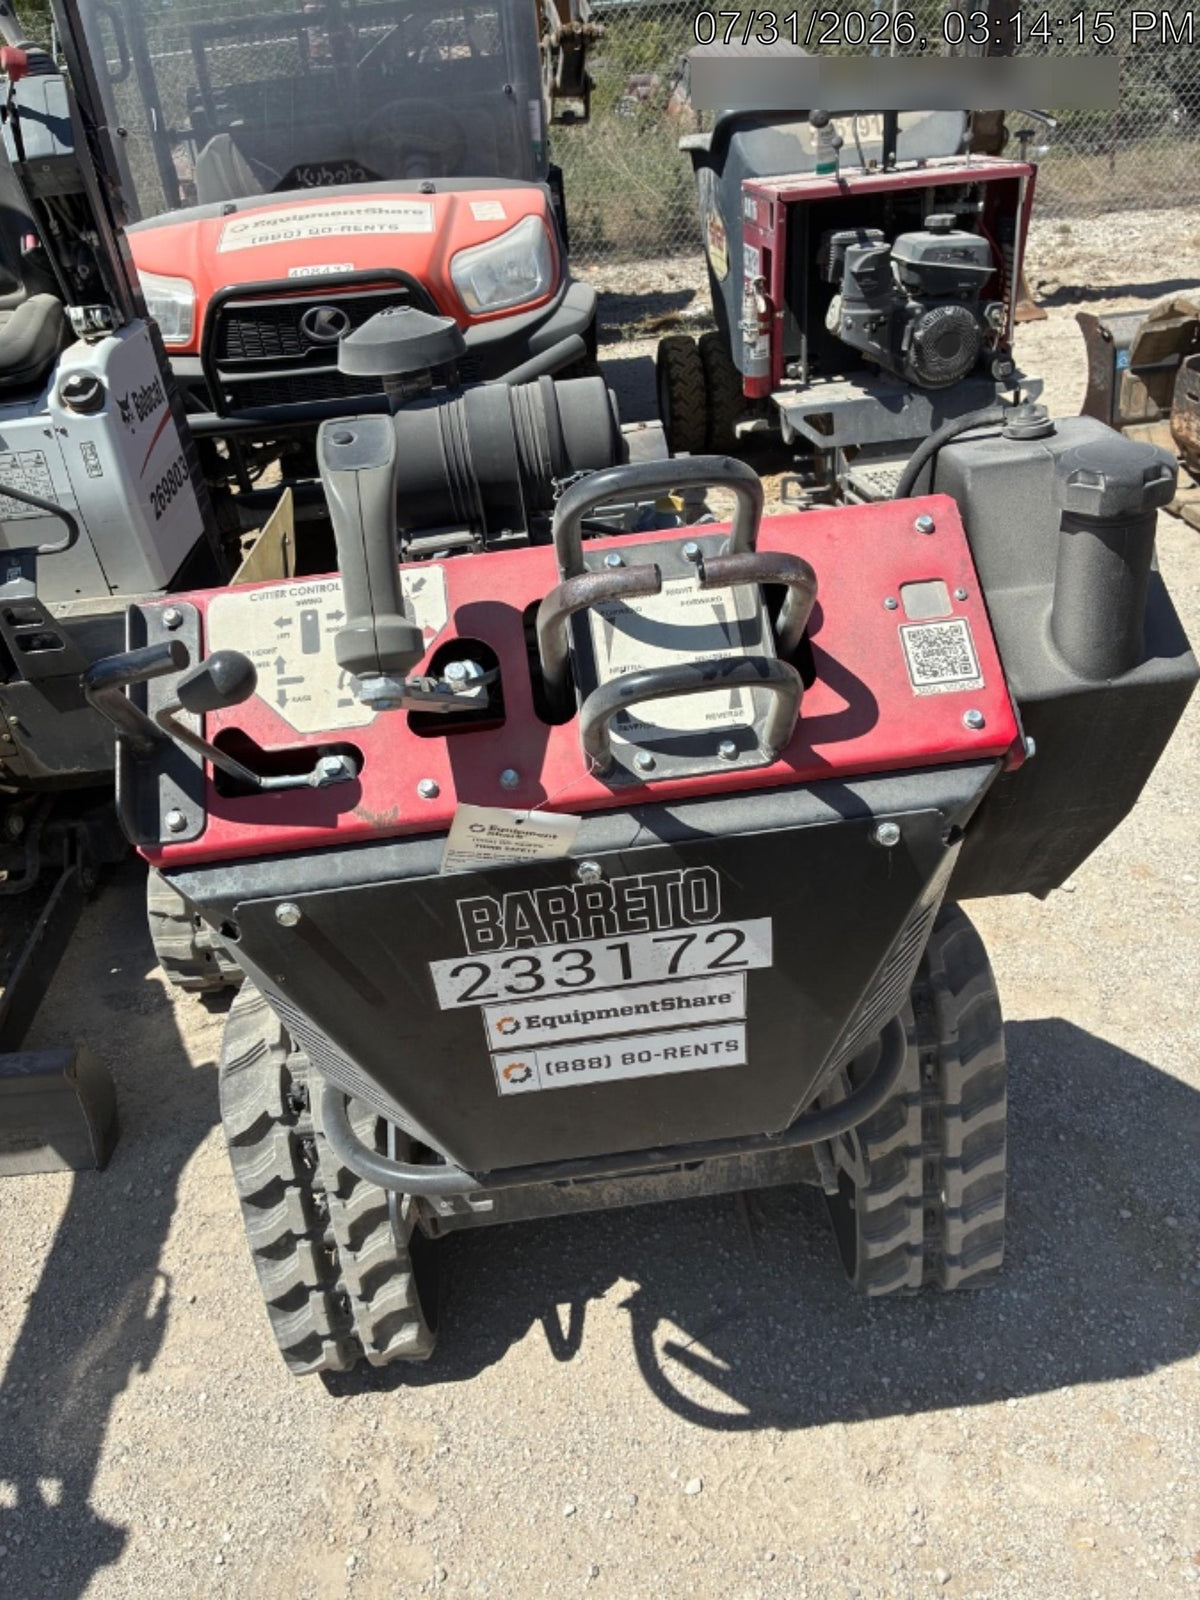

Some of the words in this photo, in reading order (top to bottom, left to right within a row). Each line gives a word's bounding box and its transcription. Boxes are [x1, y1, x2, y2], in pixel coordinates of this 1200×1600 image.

[296, 164, 367, 186] Kubota
[252, 206, 425, 229] EquipmentShare
[131, 375, 166, 422] Bobcat
[150, 454, 189, 521] 269803
[249, 589, 288, 602] CUTTER
[289, 582, 342, 597] CONTROL
[457, 865, 721, 955] BARRETO
[449, 927, 749, 1003] 233172
[524, 991, 733, 1030] EquipmentShare
[545, 1054, 612, 1076] (888)
[621, 1039, 740, 1065] 80-RENTS
